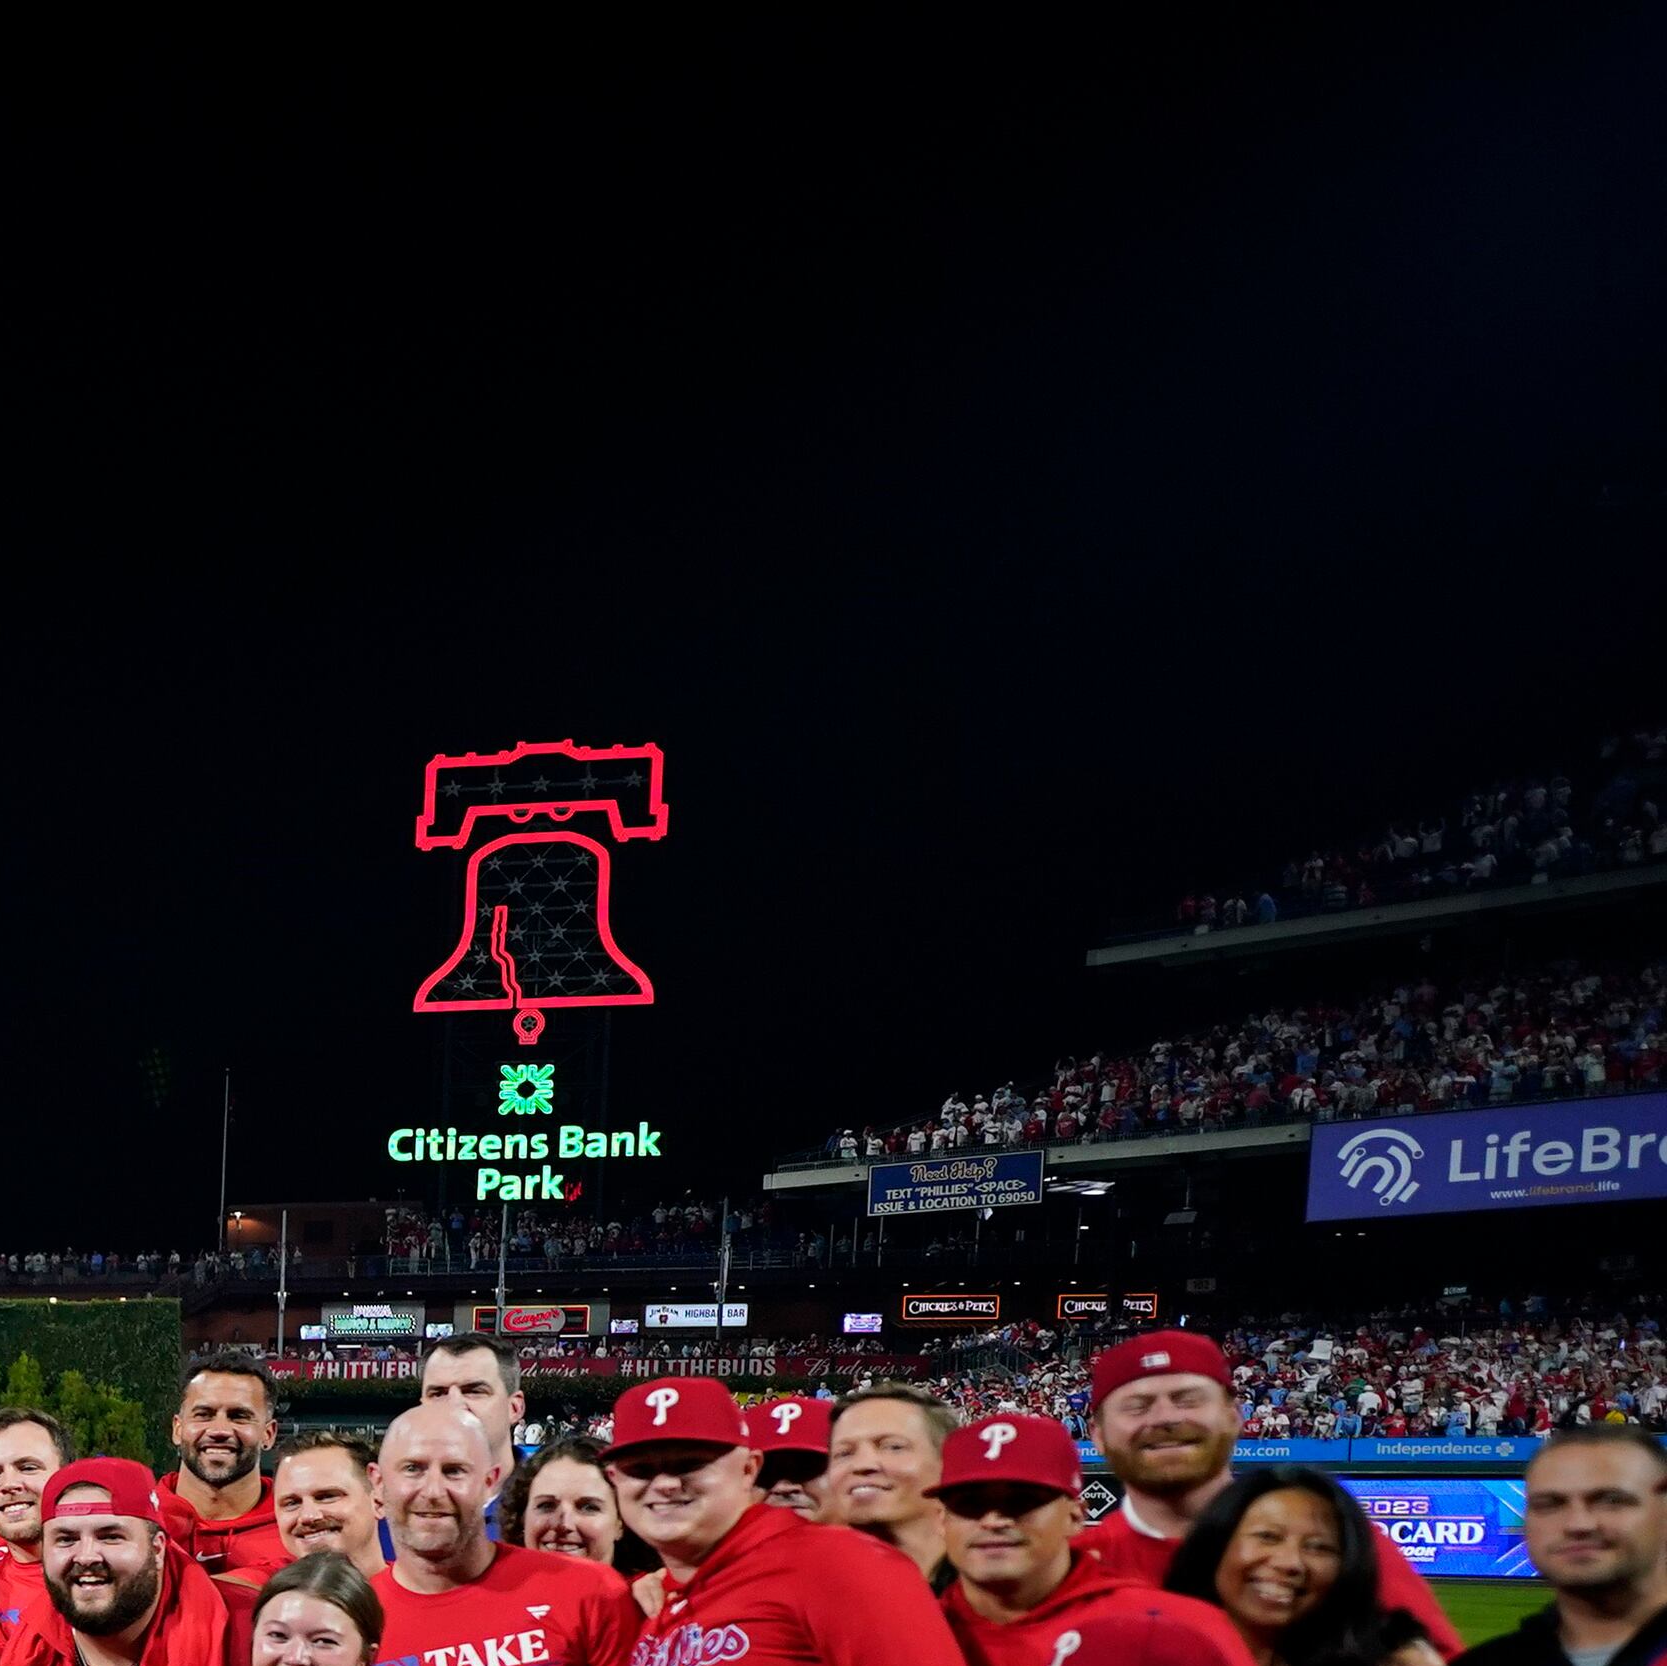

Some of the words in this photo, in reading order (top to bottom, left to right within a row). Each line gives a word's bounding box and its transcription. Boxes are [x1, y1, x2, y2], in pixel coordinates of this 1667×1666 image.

[388, 1127, 549, 1161] Citizens
[558, 1122, 662, 1158] Bank
[1448, 1127, 1667, 1183] LifeBr
[911, 1164, 948, 1183] Need
[950, 1157, 998, 1182] Help?
[476, 1166, 565, 1200] Park
[886, 1187, 912, 1200] TEXT
[975, 1179, 1028, 1194] <SPACE>
[1490, 1180, 1621, 1200] www.lifebrand.life
[874, 1201, 905, 1214] ISSUE
[908, 1200, 916, 1211] &
[920, 1196, 977, 1210] LOCATION
[979, 1194, 996, 1205] TO
[999, 1190, 1035, 1204] 69050
[727, 1308, 745, 1318] BAR
[1064, 1301, 1107, 1313] CHICKIE
[646, 1388, 678, 1425] P
[770, 1402, 802, 1434] P
[979, 1422, 1018, 1460] P
[1233, 1443, 1290, 1458] bx.com
[1376, 1442, 1492, 1458] Independence
[1083, 1490, 1107, 1500] OUTS
[1360, 1501, 1430, 1515] 2023
